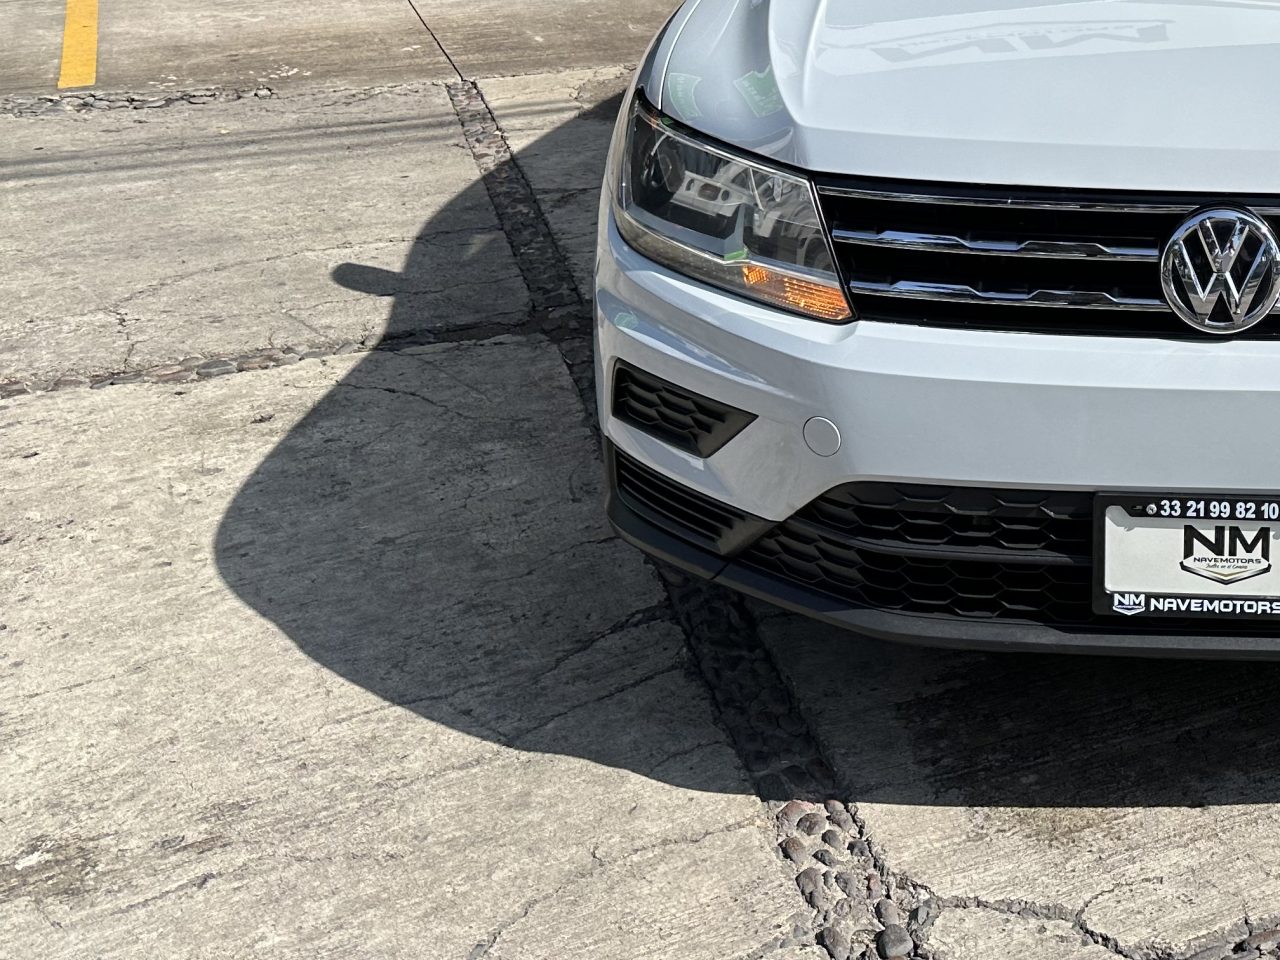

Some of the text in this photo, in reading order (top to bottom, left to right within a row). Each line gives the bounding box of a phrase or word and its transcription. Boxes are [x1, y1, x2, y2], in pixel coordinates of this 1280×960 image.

[1160, 499, 1280, 520] 33 21 99 82 10
[1183, 524, 1271, 563] NM
[1193, 556, 1262, 565] NAVEMOTORS
[1114, 593, 1145, 607] NM
